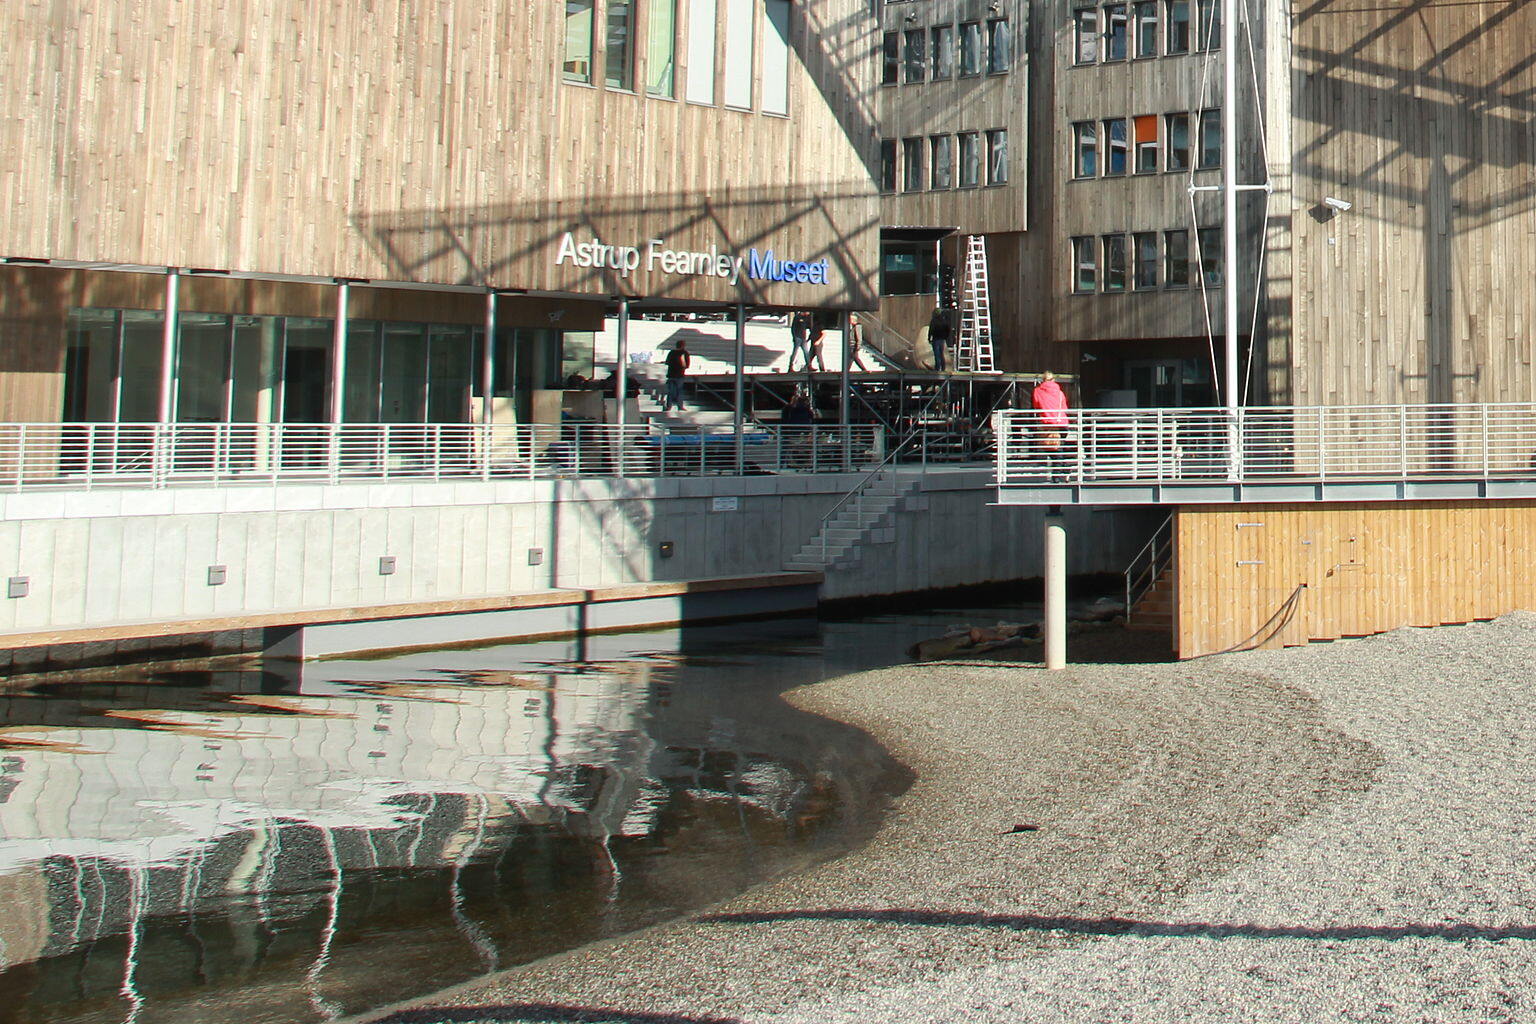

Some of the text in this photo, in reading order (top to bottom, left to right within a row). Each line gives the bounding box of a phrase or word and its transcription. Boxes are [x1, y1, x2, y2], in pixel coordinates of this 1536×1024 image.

[556, 232, 830, 285] Astrup Fearnley Museet
